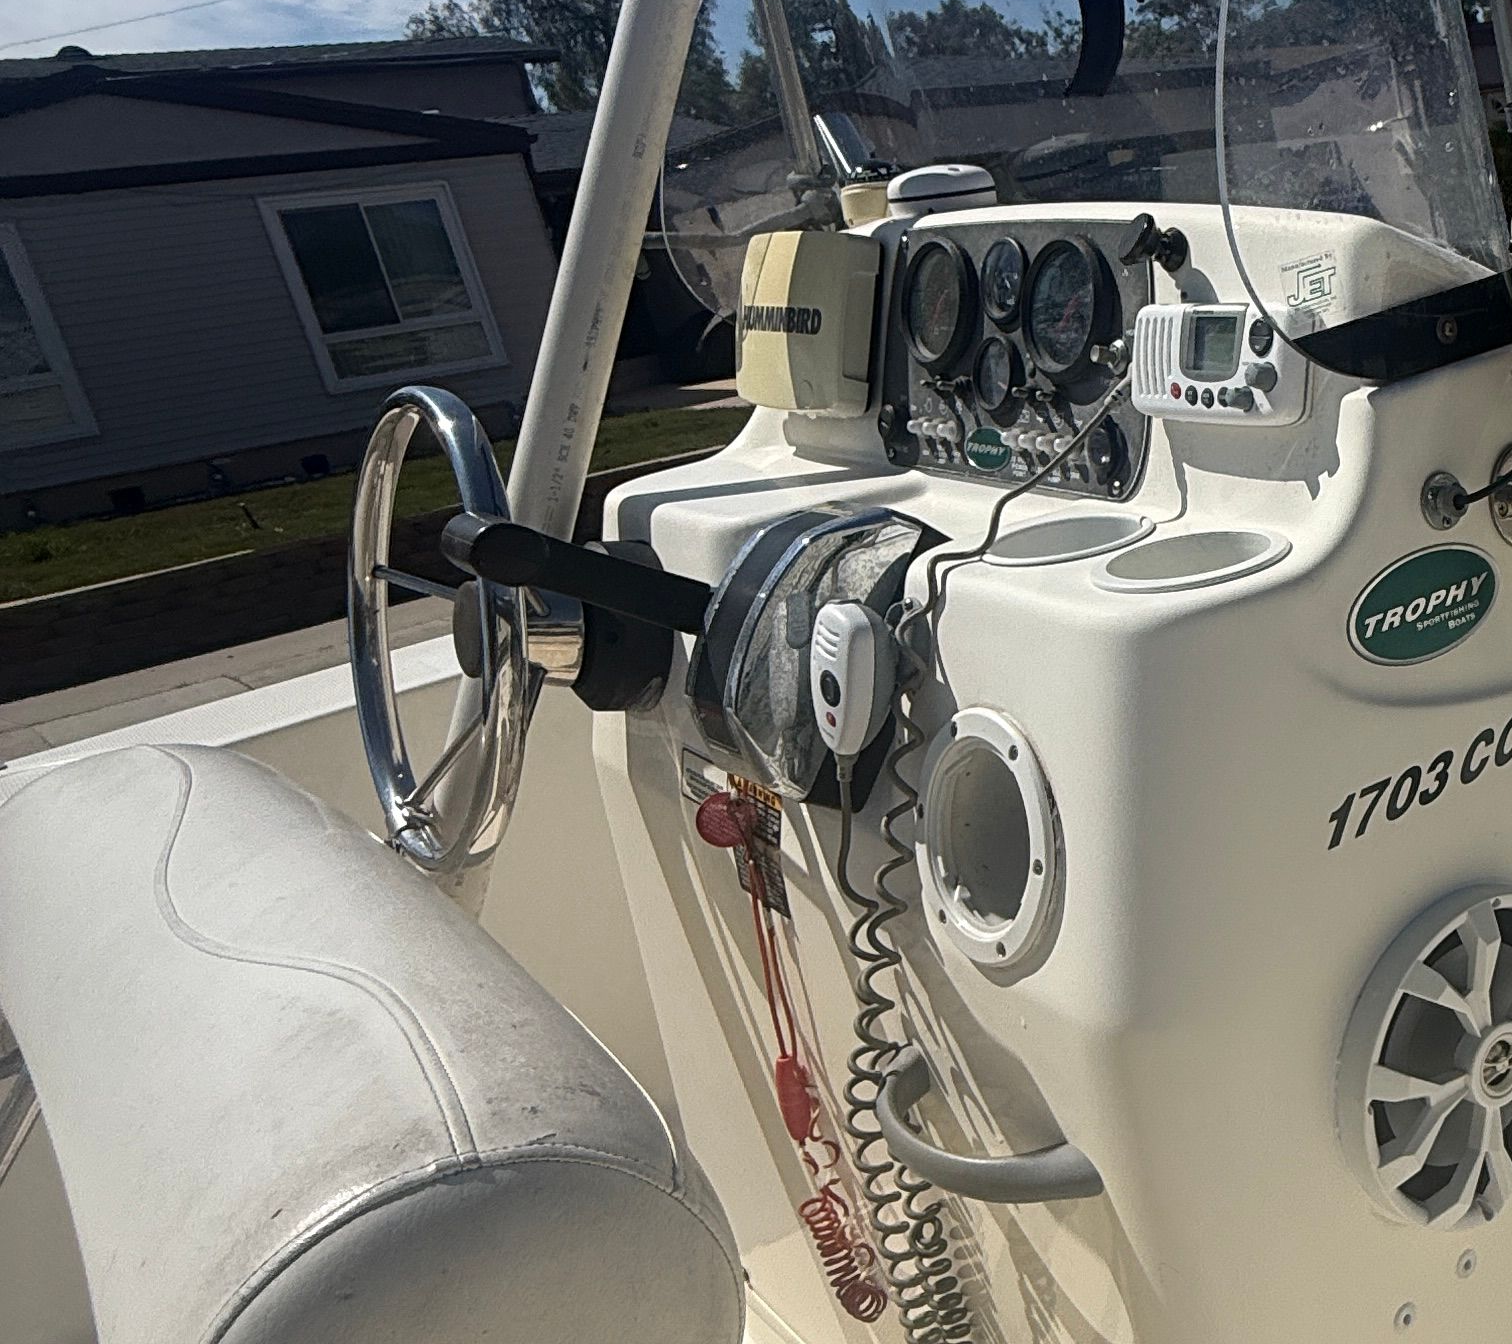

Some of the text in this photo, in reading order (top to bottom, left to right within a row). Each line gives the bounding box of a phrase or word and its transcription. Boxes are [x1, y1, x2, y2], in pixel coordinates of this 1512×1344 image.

[1286, 263, 1337, 308] JET
[966, 441, 1007, 457] TROPHY
[1363, 571, 1489, 640] TROPHY
[1447, 612, 1477, 631] BOATS
[1327, 749, 1455, 852] 1703
